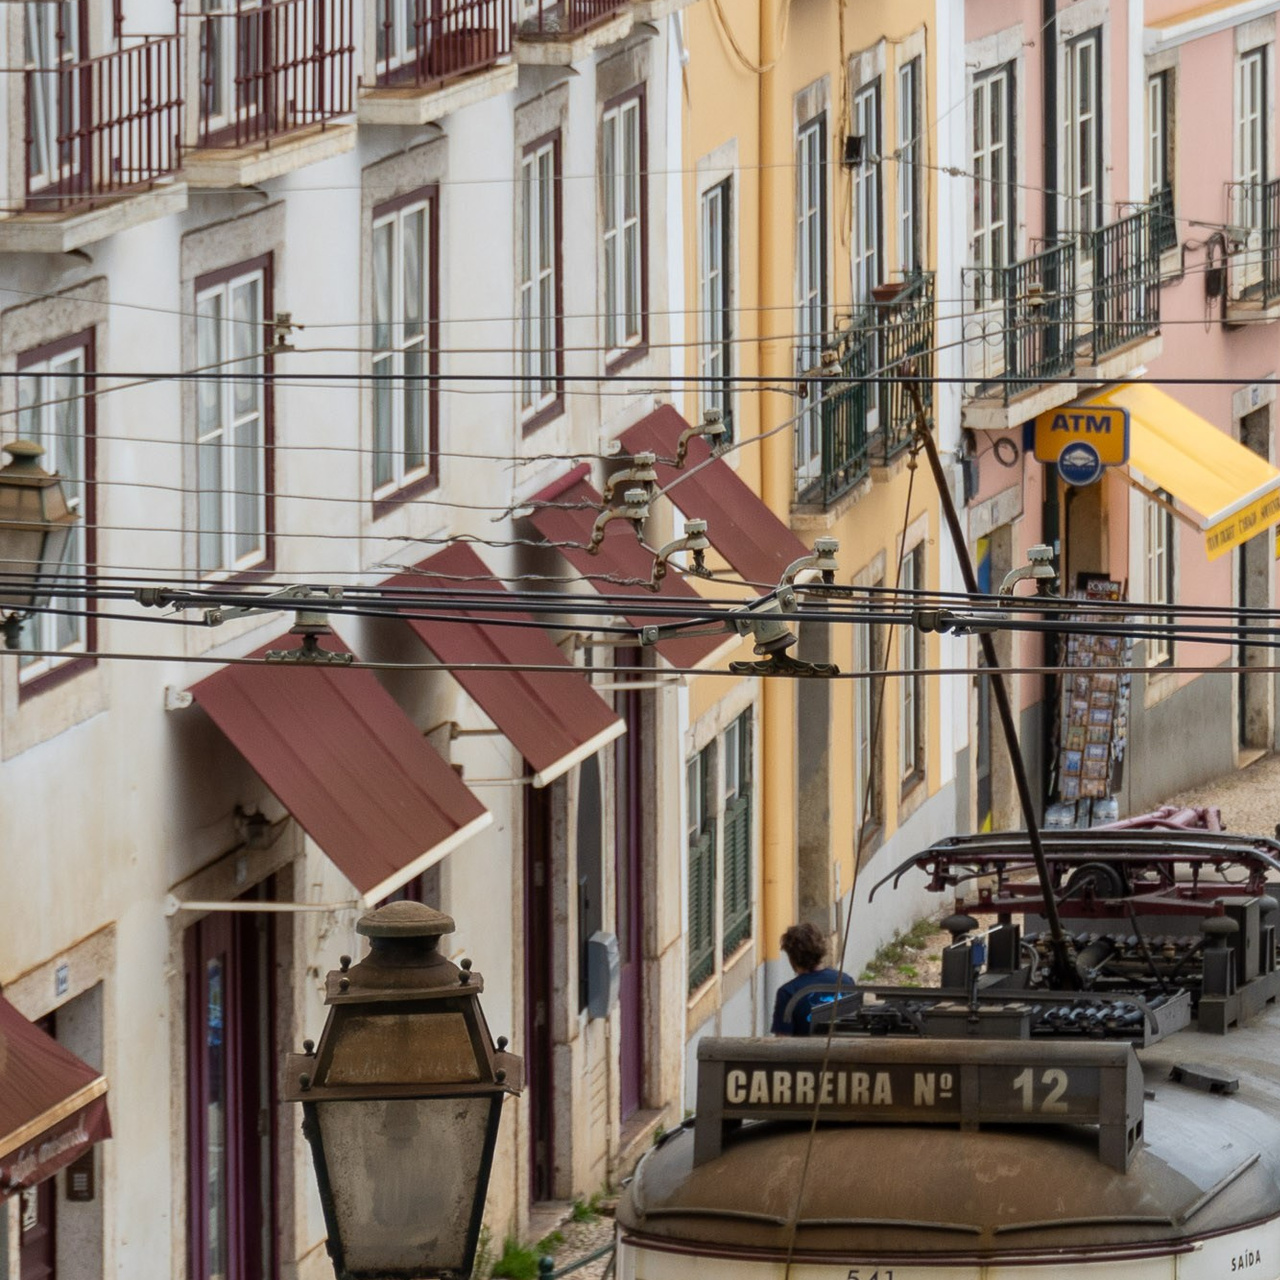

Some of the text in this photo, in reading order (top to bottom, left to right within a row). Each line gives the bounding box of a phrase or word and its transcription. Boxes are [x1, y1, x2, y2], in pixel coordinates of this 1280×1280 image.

[1051, 413, 1111, 434] ATM
[726, 1067, 1069, 1113] CARREIRA Nº 12
[1231, 1250, 1262, 1272] SAÍDA
